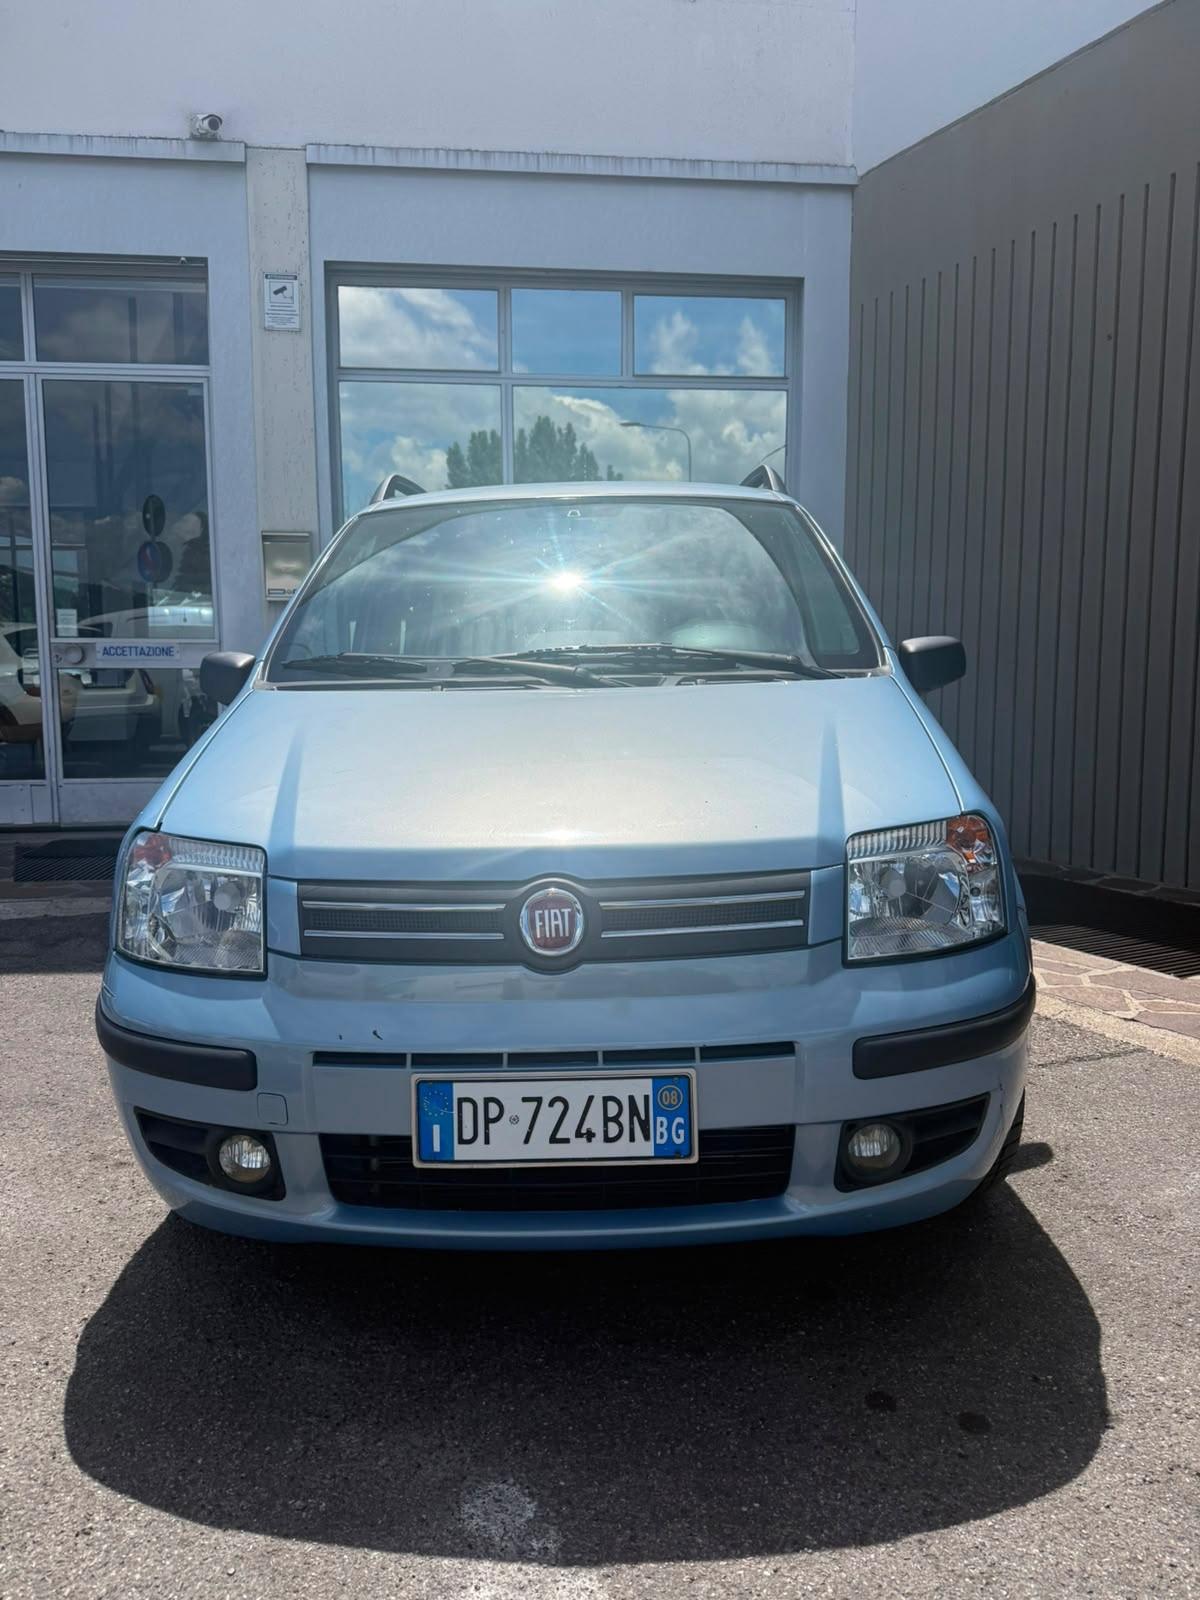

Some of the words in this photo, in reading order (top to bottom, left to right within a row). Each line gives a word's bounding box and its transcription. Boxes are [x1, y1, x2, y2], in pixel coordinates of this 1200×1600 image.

[102, 646, 175, 657] ACCETTAZIONE
[534, 908, 572, 939] FIAT
[661, 1090, 678, 1105] 08
[457, 1096, 505, 1145] DP
[521, 1094, 651, 1145] 724BN
[655, 1116, 685, 1145] BG
